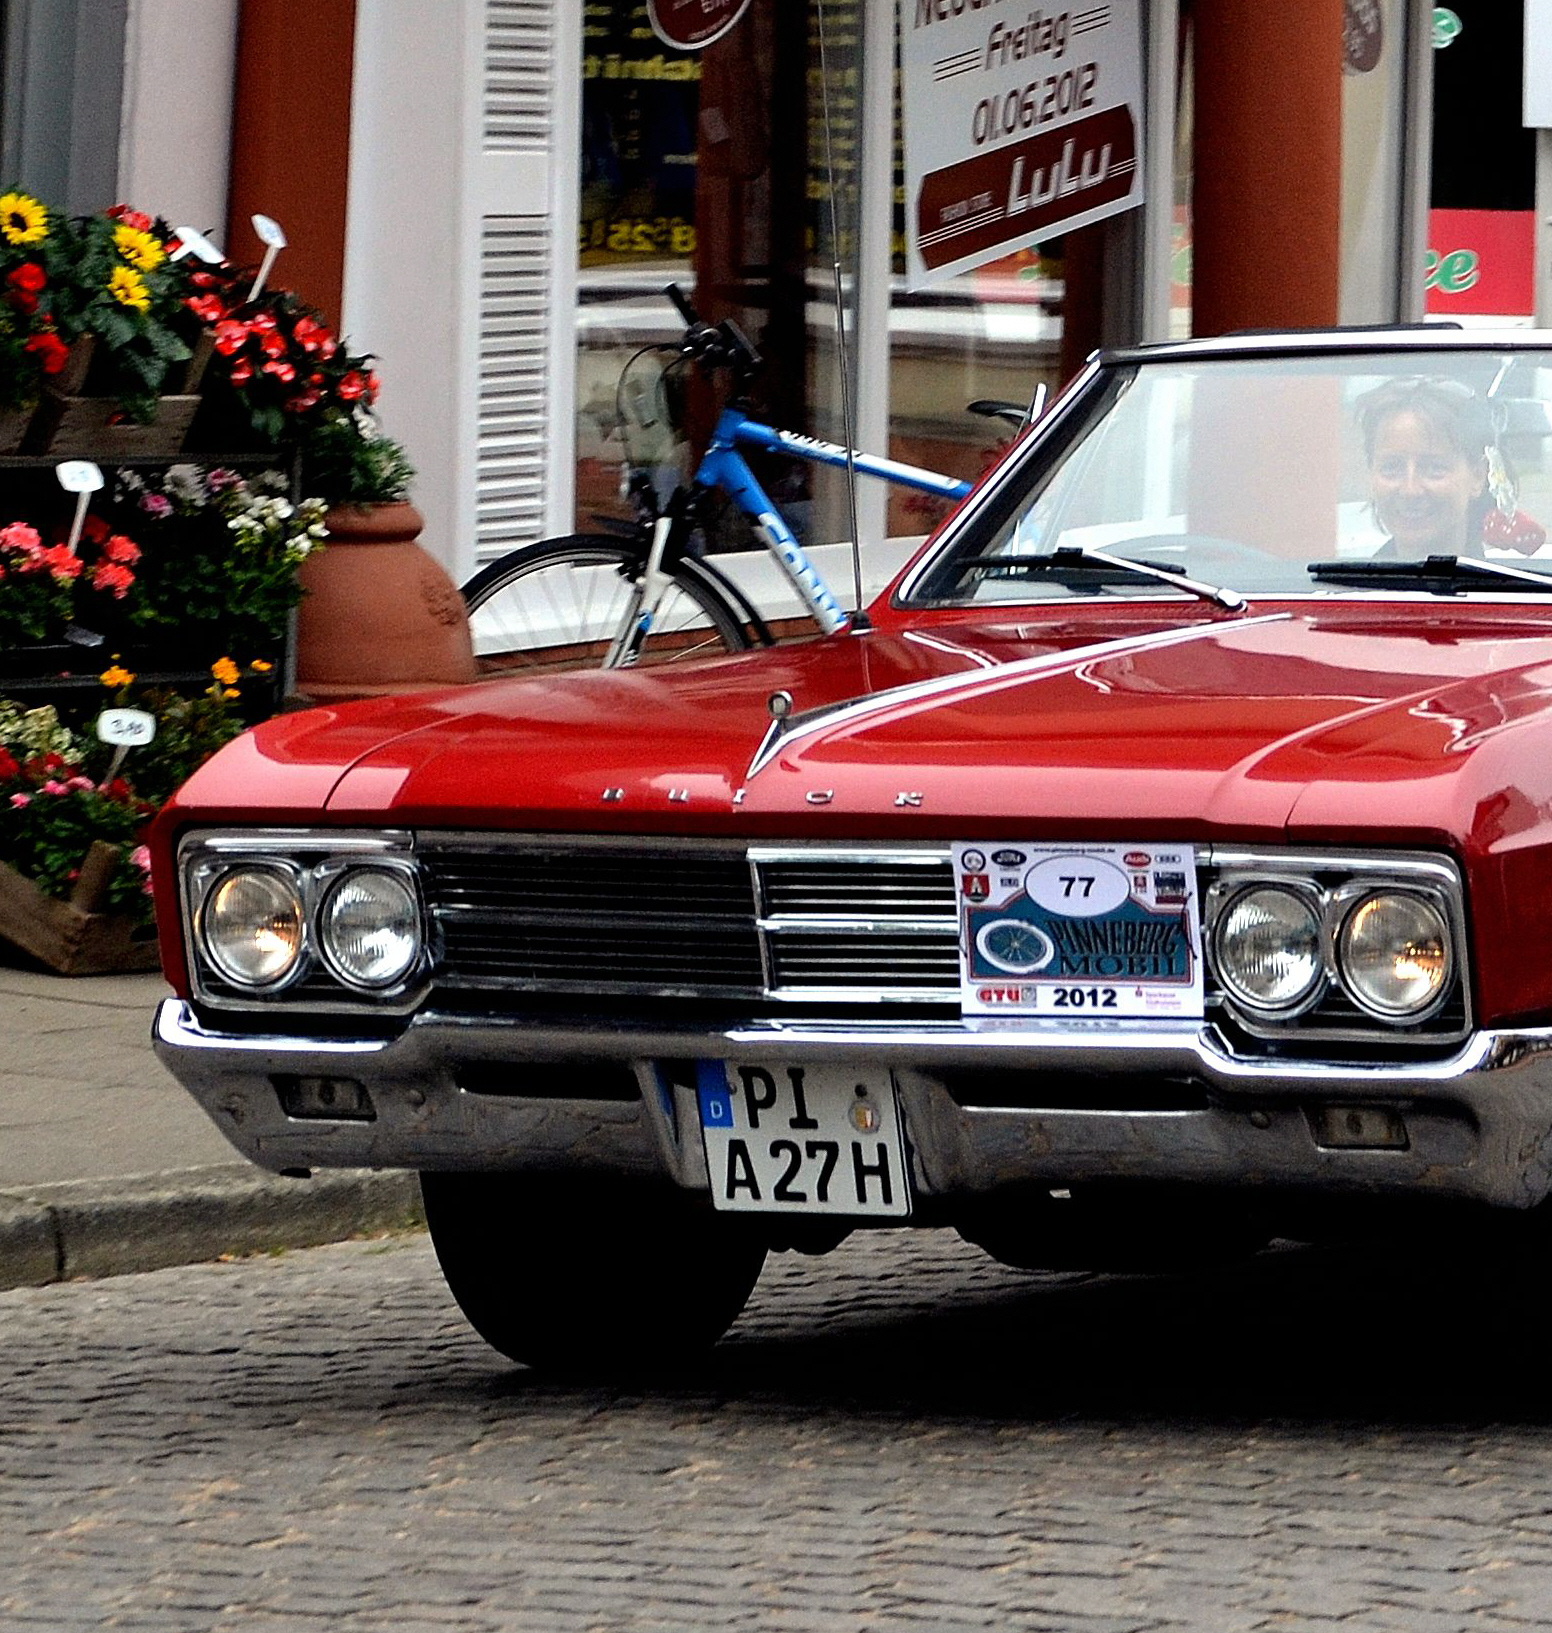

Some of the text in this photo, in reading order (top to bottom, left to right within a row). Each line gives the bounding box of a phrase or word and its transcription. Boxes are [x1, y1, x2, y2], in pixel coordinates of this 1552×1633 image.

[972, 61, 1099, 146] 01.06.2012
[1059, 876, 1095, 897] 77
[1060, 955, 1185, 976] MOBIL
[1053, 988, 1117, 1007] 2012
[738, 1066, 819, 1129] PI
[710, 1101, 723, 1118] D
[725, 1139, 893, 1204] A27H
